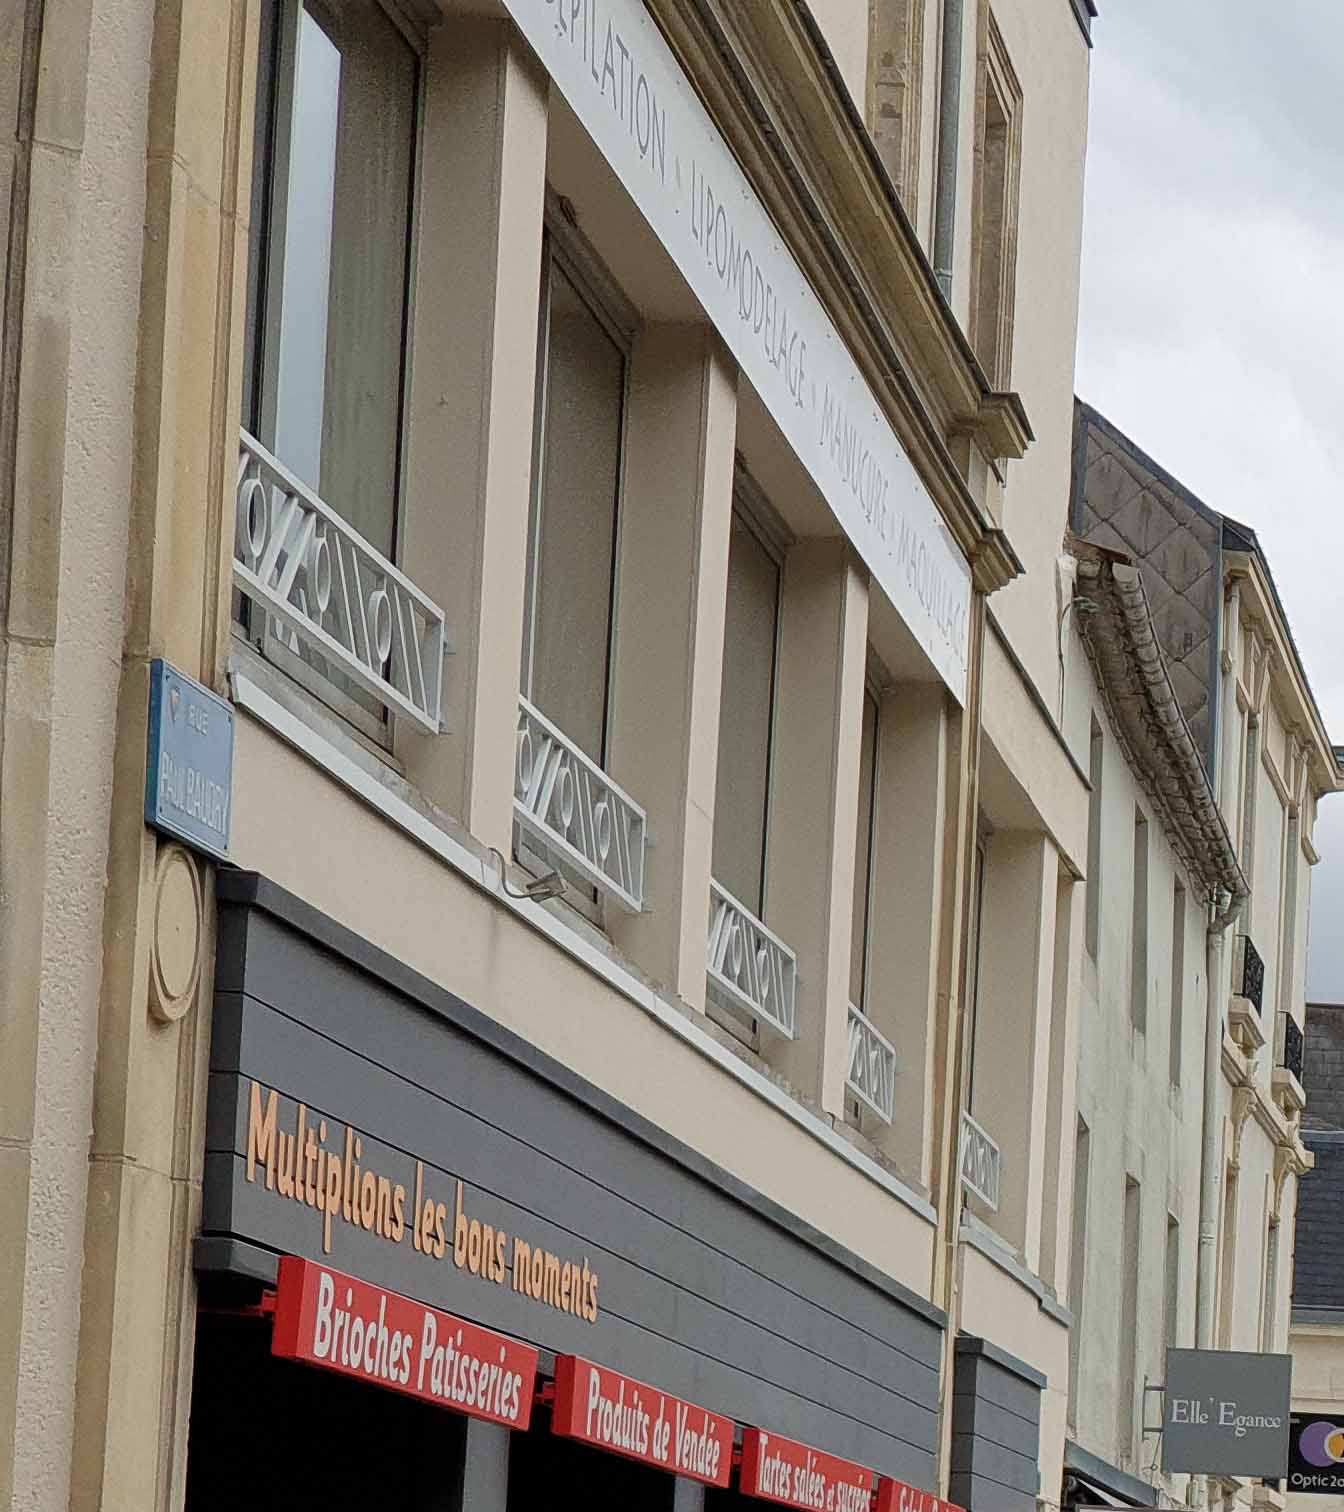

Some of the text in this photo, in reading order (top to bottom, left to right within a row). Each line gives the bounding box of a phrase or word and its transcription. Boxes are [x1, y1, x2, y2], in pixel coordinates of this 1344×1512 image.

[247, 1081, 600, 1324] Multiplions les bons moments
[313, 1272, 523, 1421] Brioches Patisseries
[586, 1368, 720, 1479] Produits de Vendée
[759, 1432, 792, 1499] Tartes
[793, 1451, 826, 1510] salées
